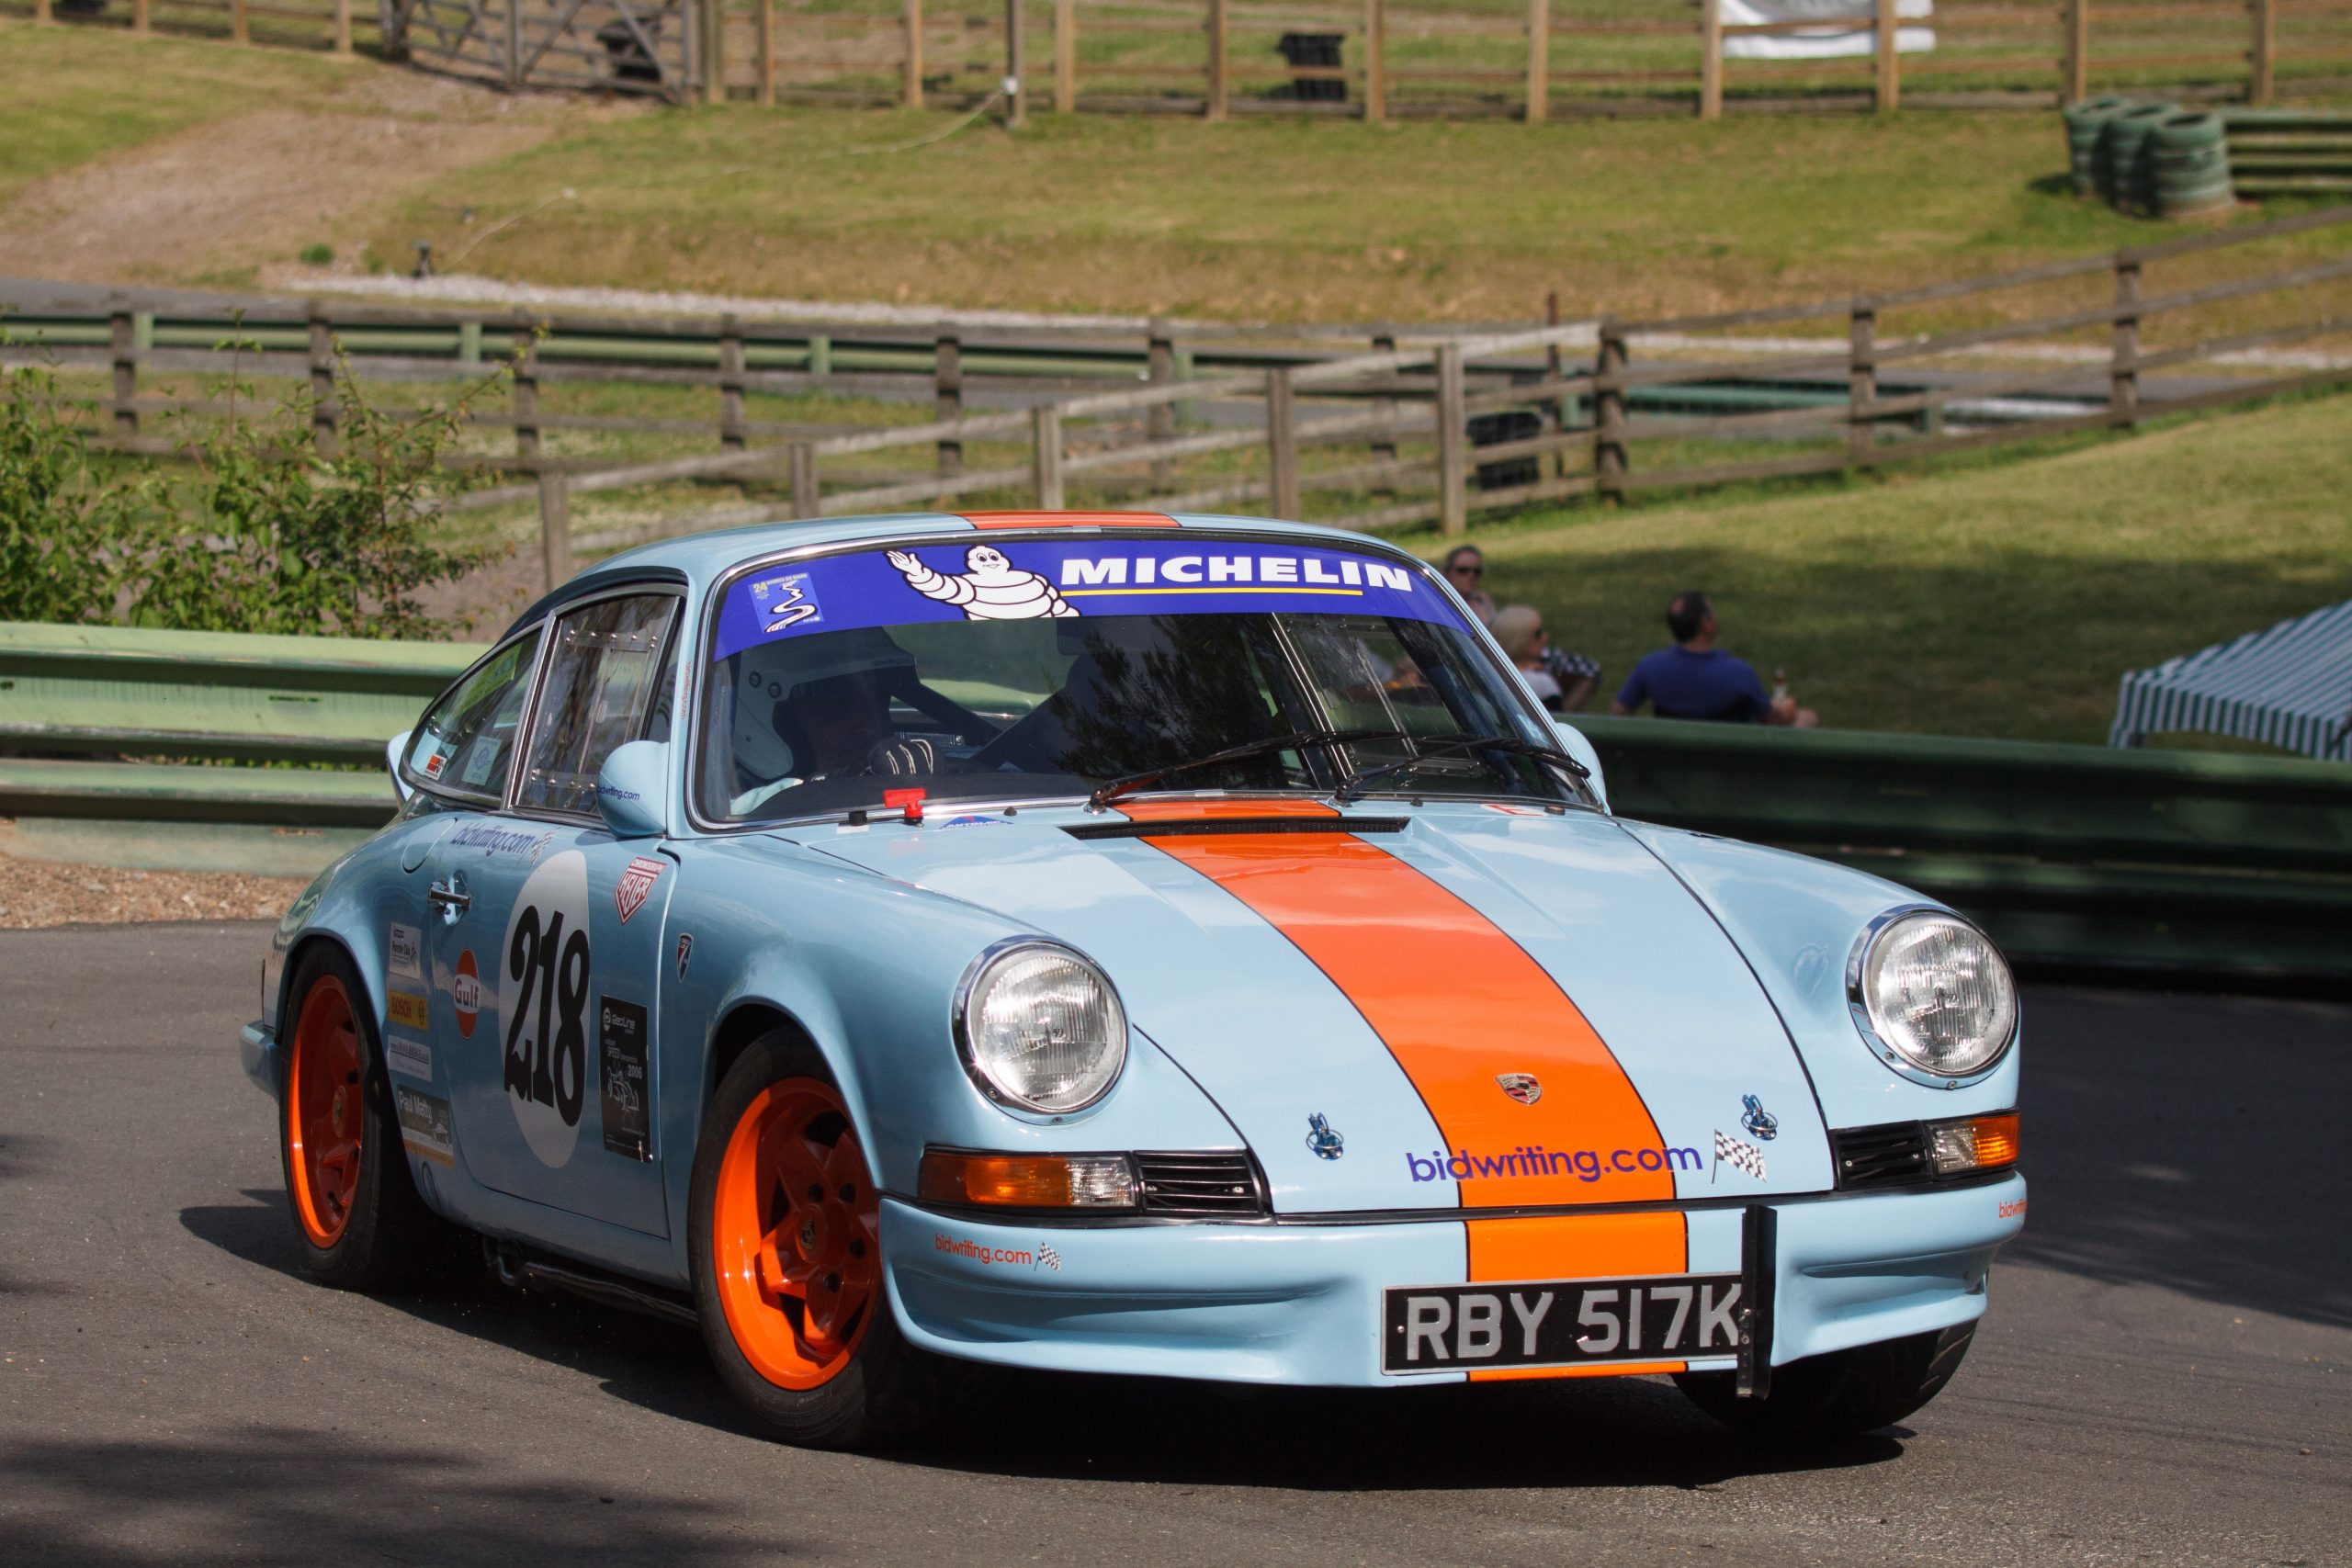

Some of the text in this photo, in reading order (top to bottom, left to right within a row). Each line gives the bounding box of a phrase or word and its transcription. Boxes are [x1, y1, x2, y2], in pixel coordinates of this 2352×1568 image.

[1060, 556, 1412, 592] MICHELIN
[618, 873, 653, 915] HEUER
[454, 974, 480, 1010] Gulf
[503, 905, 591, 1128] 218
[1405, 1143, 1703, 1183] bidwriting.com
[934, 1233, 1032, 1265] bidwriting.com
[1406, 1282, 1743, 1361] RBY 517K
